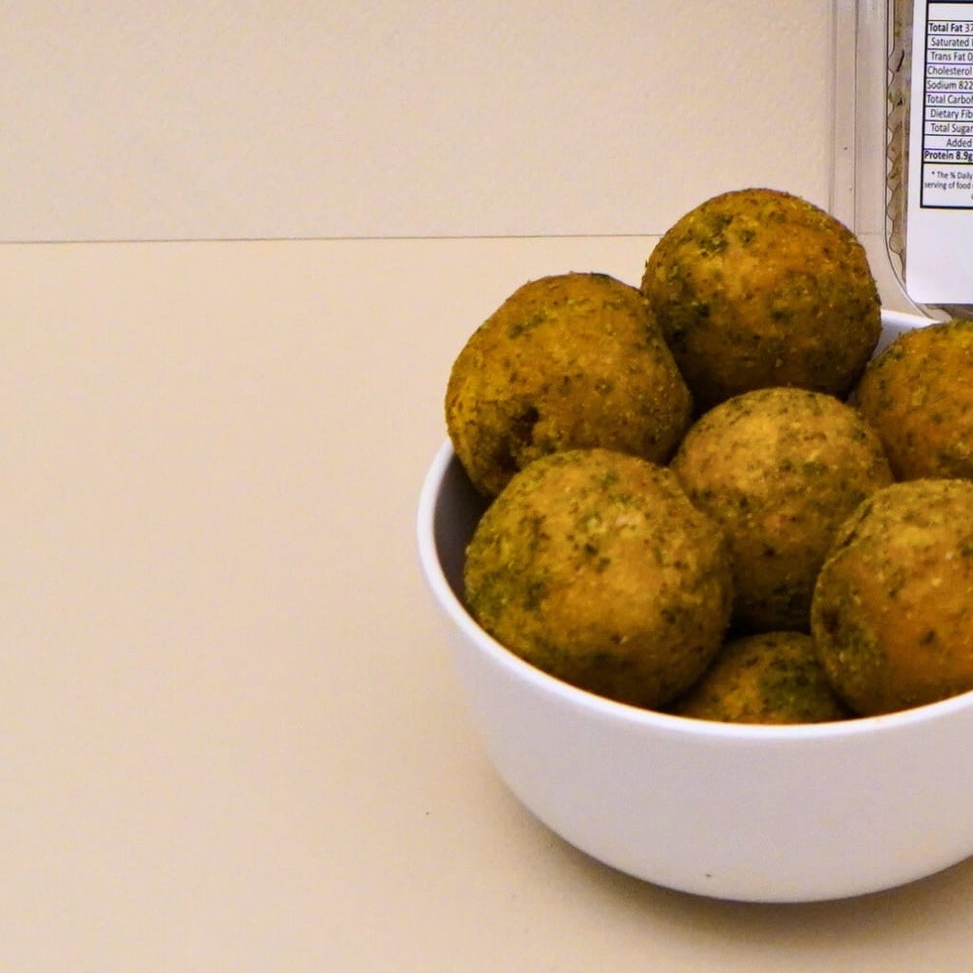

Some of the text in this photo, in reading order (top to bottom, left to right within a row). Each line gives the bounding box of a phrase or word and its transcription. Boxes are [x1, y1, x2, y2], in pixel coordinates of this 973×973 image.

[928, 23, 949, 33] Total
[950, 23, 963, 32] Fat
[930, 37, 970, 47] Saturated
[931, 52, 952, 61] Trans
[953, 52, 966, 63] Fat
[927, 66, 972, 78] Cholesterol
[926, 81, 957, 92] Sodium
[926, 95, 946, 106] Total
[930, 109, 959, 120] Dietary
[931, 123, 950, 132] Total
[951, 124, 973, 134] Sugar
[946, 138, 972, 147] Added
[924, 151, 954, 162] Protein
[955, 152, 973, 163] 8.9g
